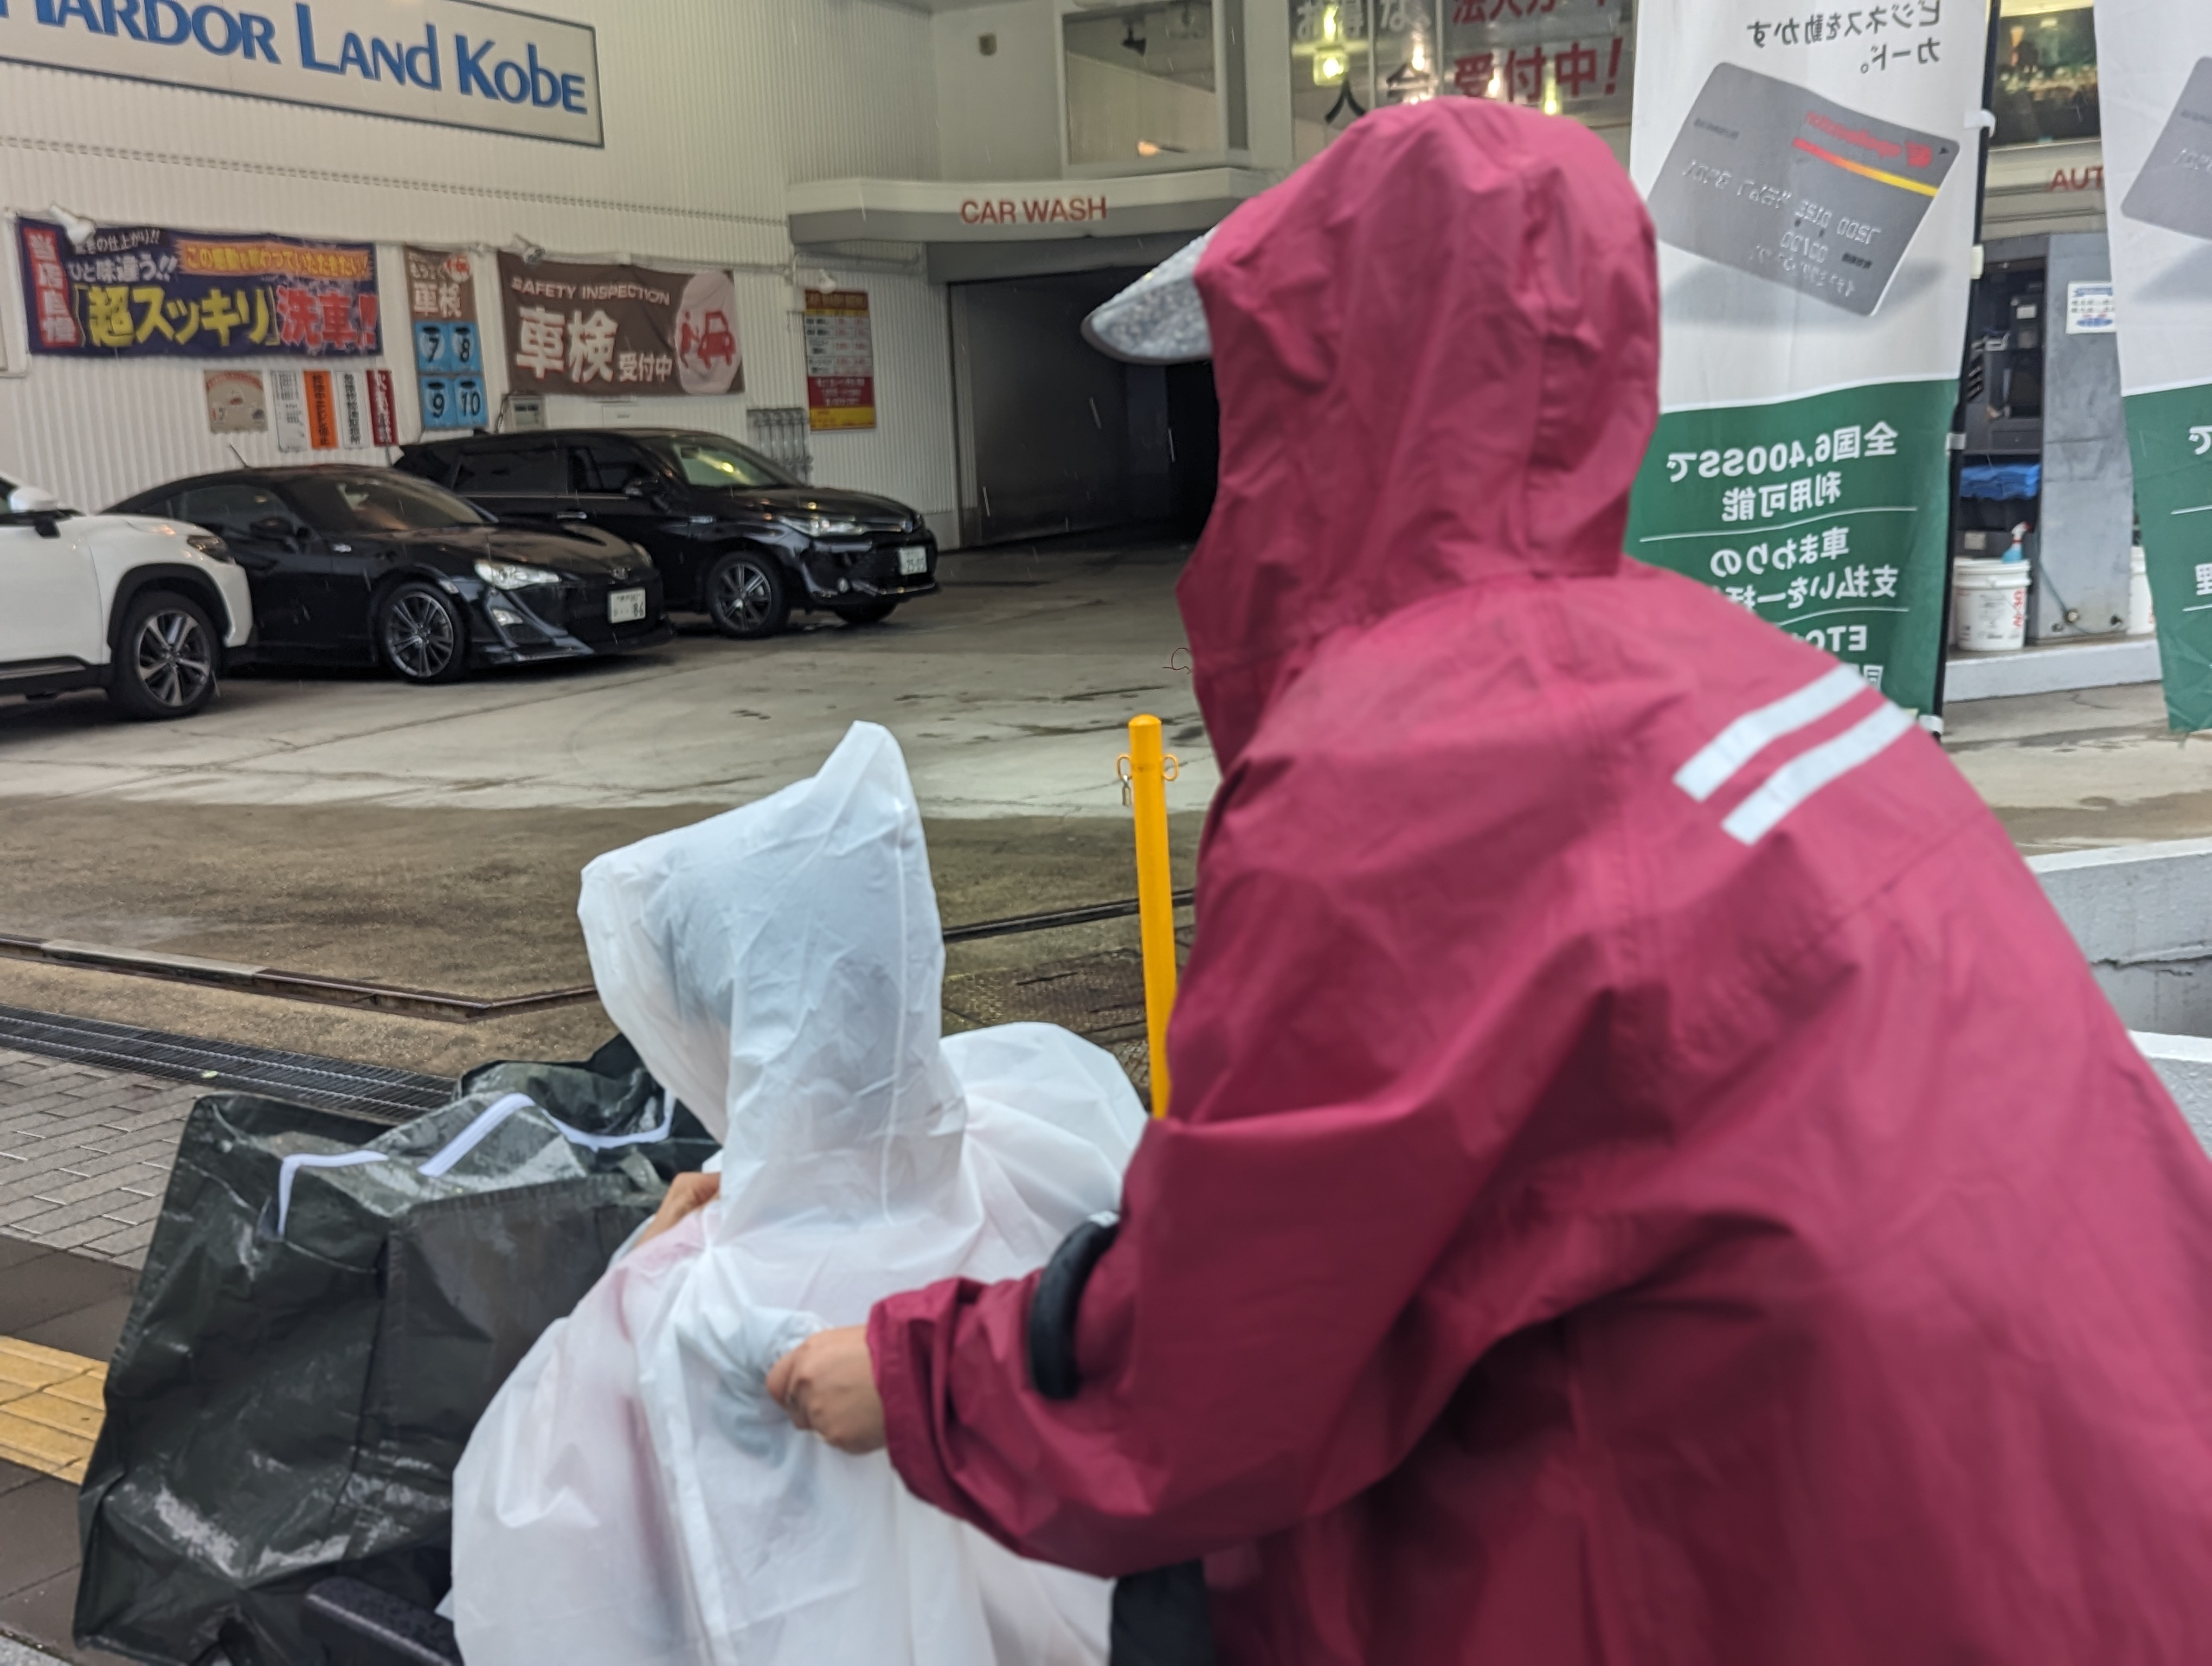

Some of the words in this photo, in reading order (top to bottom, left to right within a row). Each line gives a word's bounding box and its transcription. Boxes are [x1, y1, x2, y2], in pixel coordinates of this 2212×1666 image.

[2049, 165, 2104, 191] AUT
[961, 201, 1016, 223] CAR
[1023, 197, 1107, 223] WASH
[512, 277, 577, 299] SAFETY
[582, 283, 671, 306] INSPECTION
[429, 336, 440, 363] 7
[460, 336, 471, 362] 8
[516, 306, 619, 384] 車検
[619, 353, 673, 382] 受付中
[433, 393, 445, 418] 9
[461, 392, 481, 417] 10
